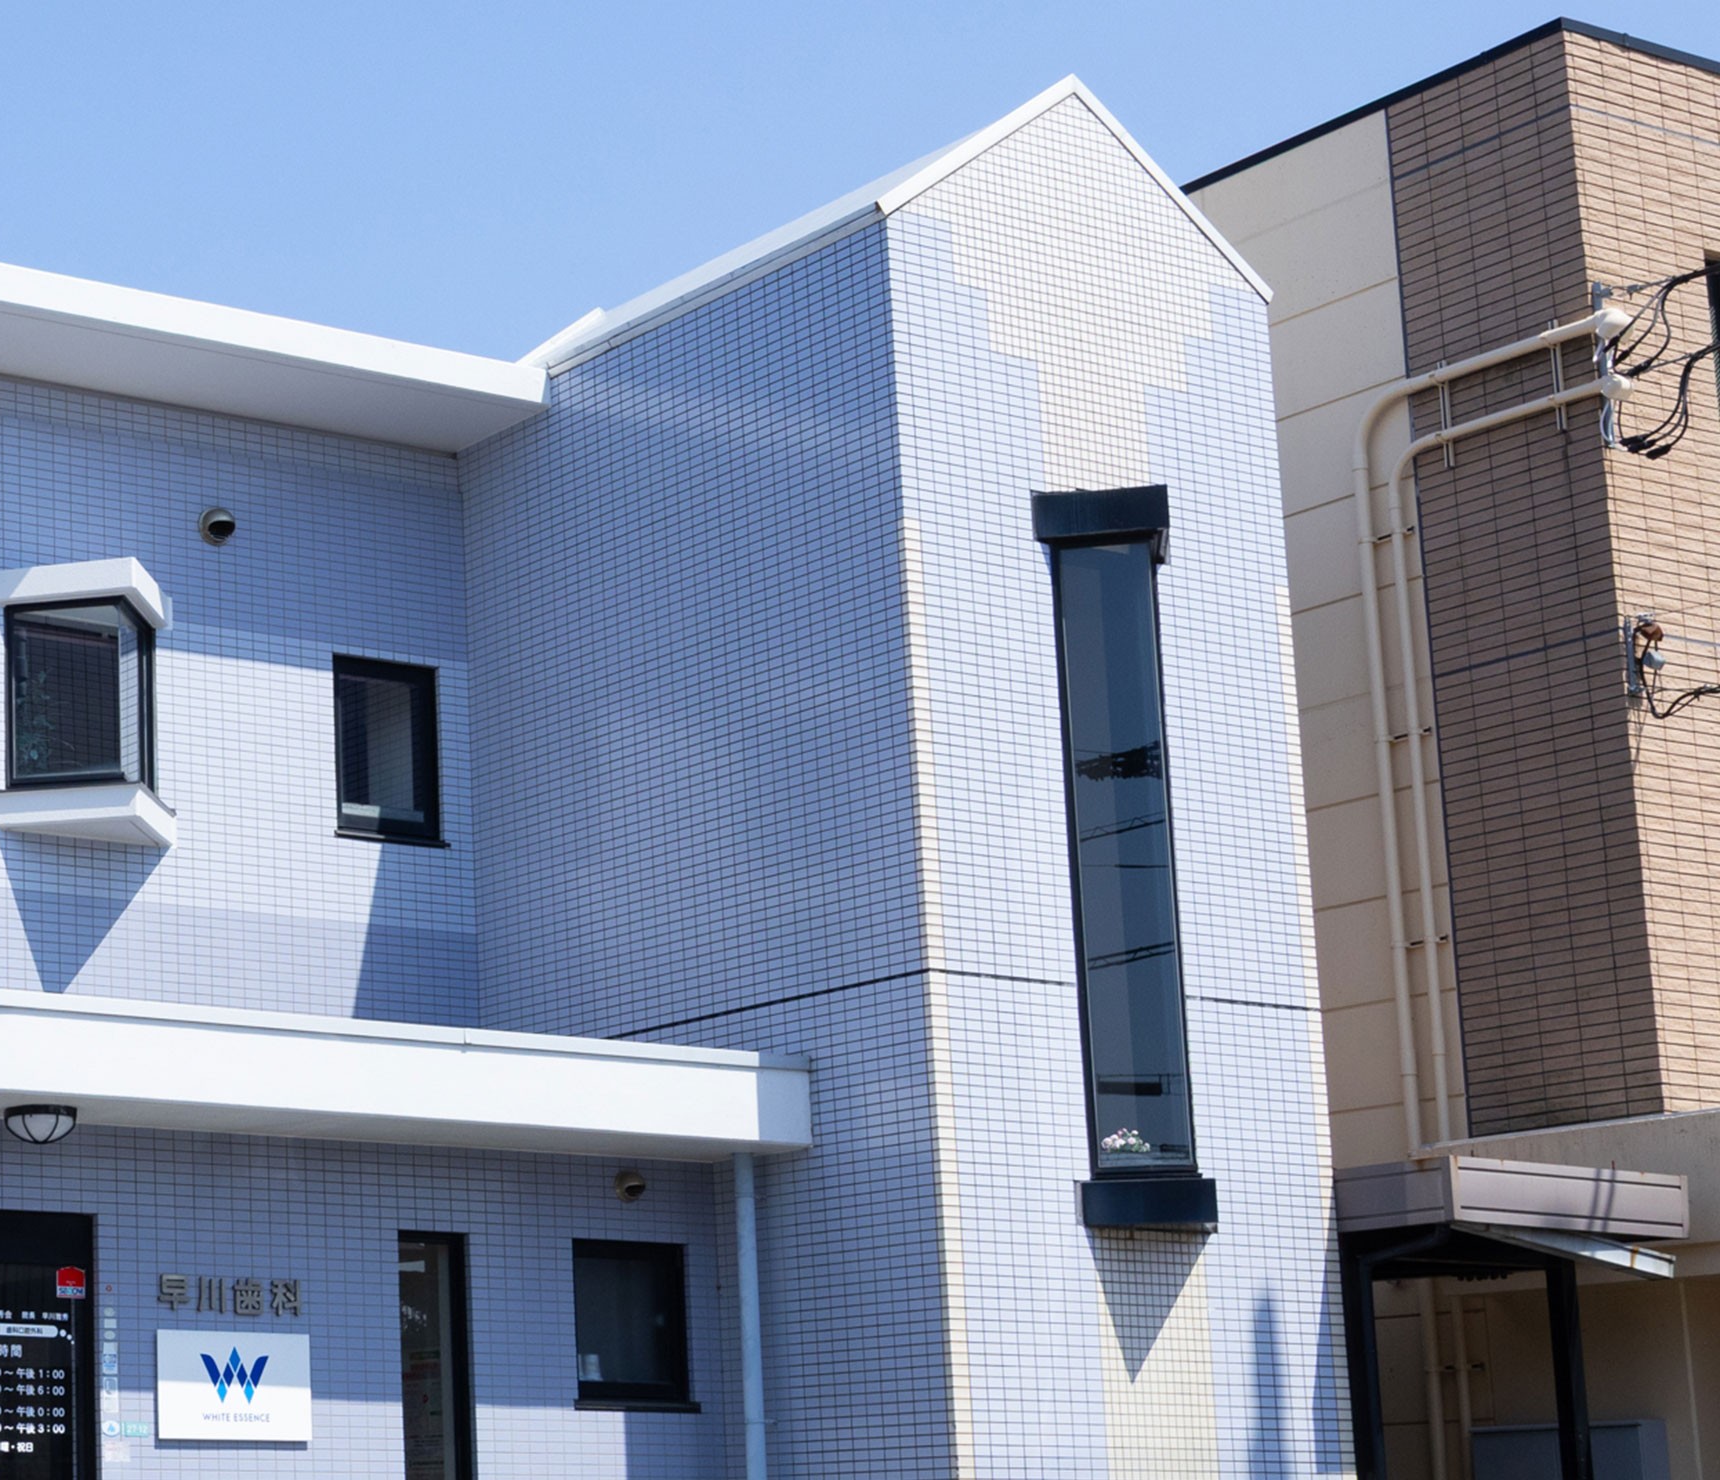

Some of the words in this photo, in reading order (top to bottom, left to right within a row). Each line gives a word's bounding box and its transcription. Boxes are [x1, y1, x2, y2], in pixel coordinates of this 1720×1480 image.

[157, 1274, 301, 1317] 早川歯科
[202, 1412, 231, 1422] WHITE
[233, 1412, 271, 1423] ESSENCE
